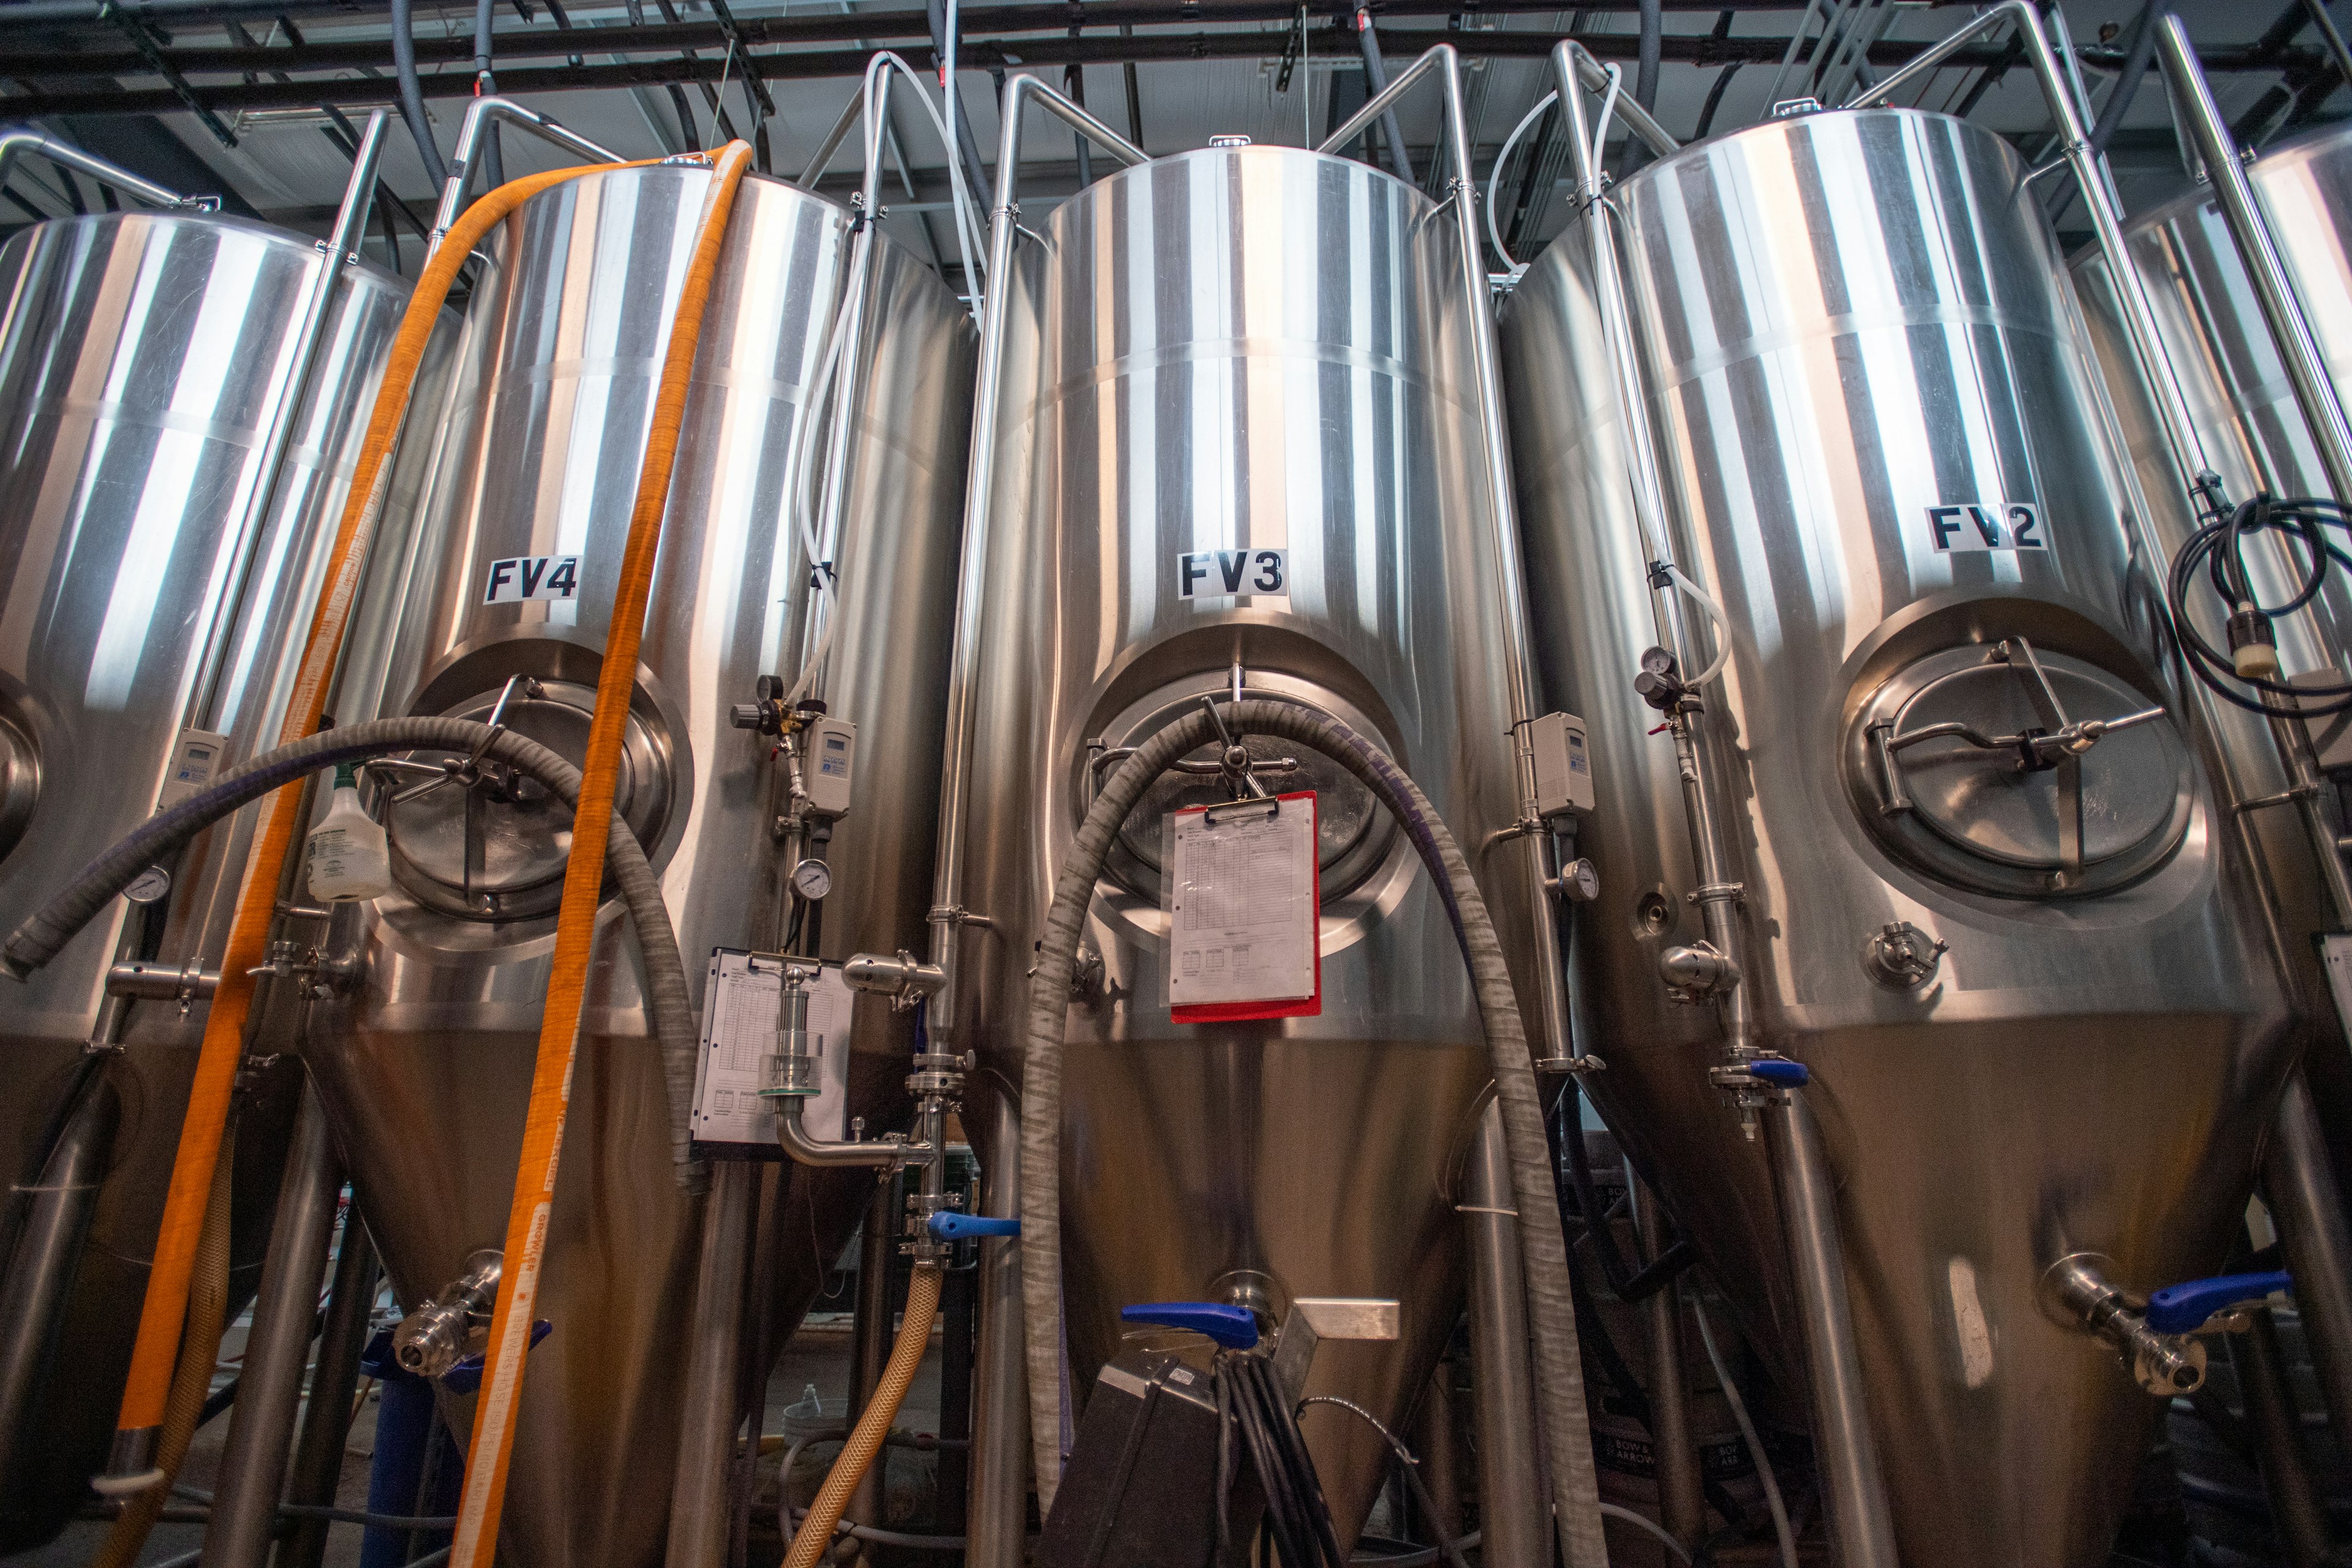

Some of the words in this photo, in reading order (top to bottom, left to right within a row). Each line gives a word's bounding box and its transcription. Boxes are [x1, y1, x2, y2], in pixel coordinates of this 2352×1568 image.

[1929, 506, 2041, 549] FV2
[487, 557, 577, 601] FV4
[1182, 551, 1283, 596] FV3
[526, 1213, 546, 1273] GROWLER
[502, 1314, 523, 1371] BREWERS
[493, 1372, 509, 1407] HOSE
[488, 1409, 500, 1430] 150
[1615, 1439, 1640, 1451] BOW
[1616, 1450, 1656, 1464] ARROW
